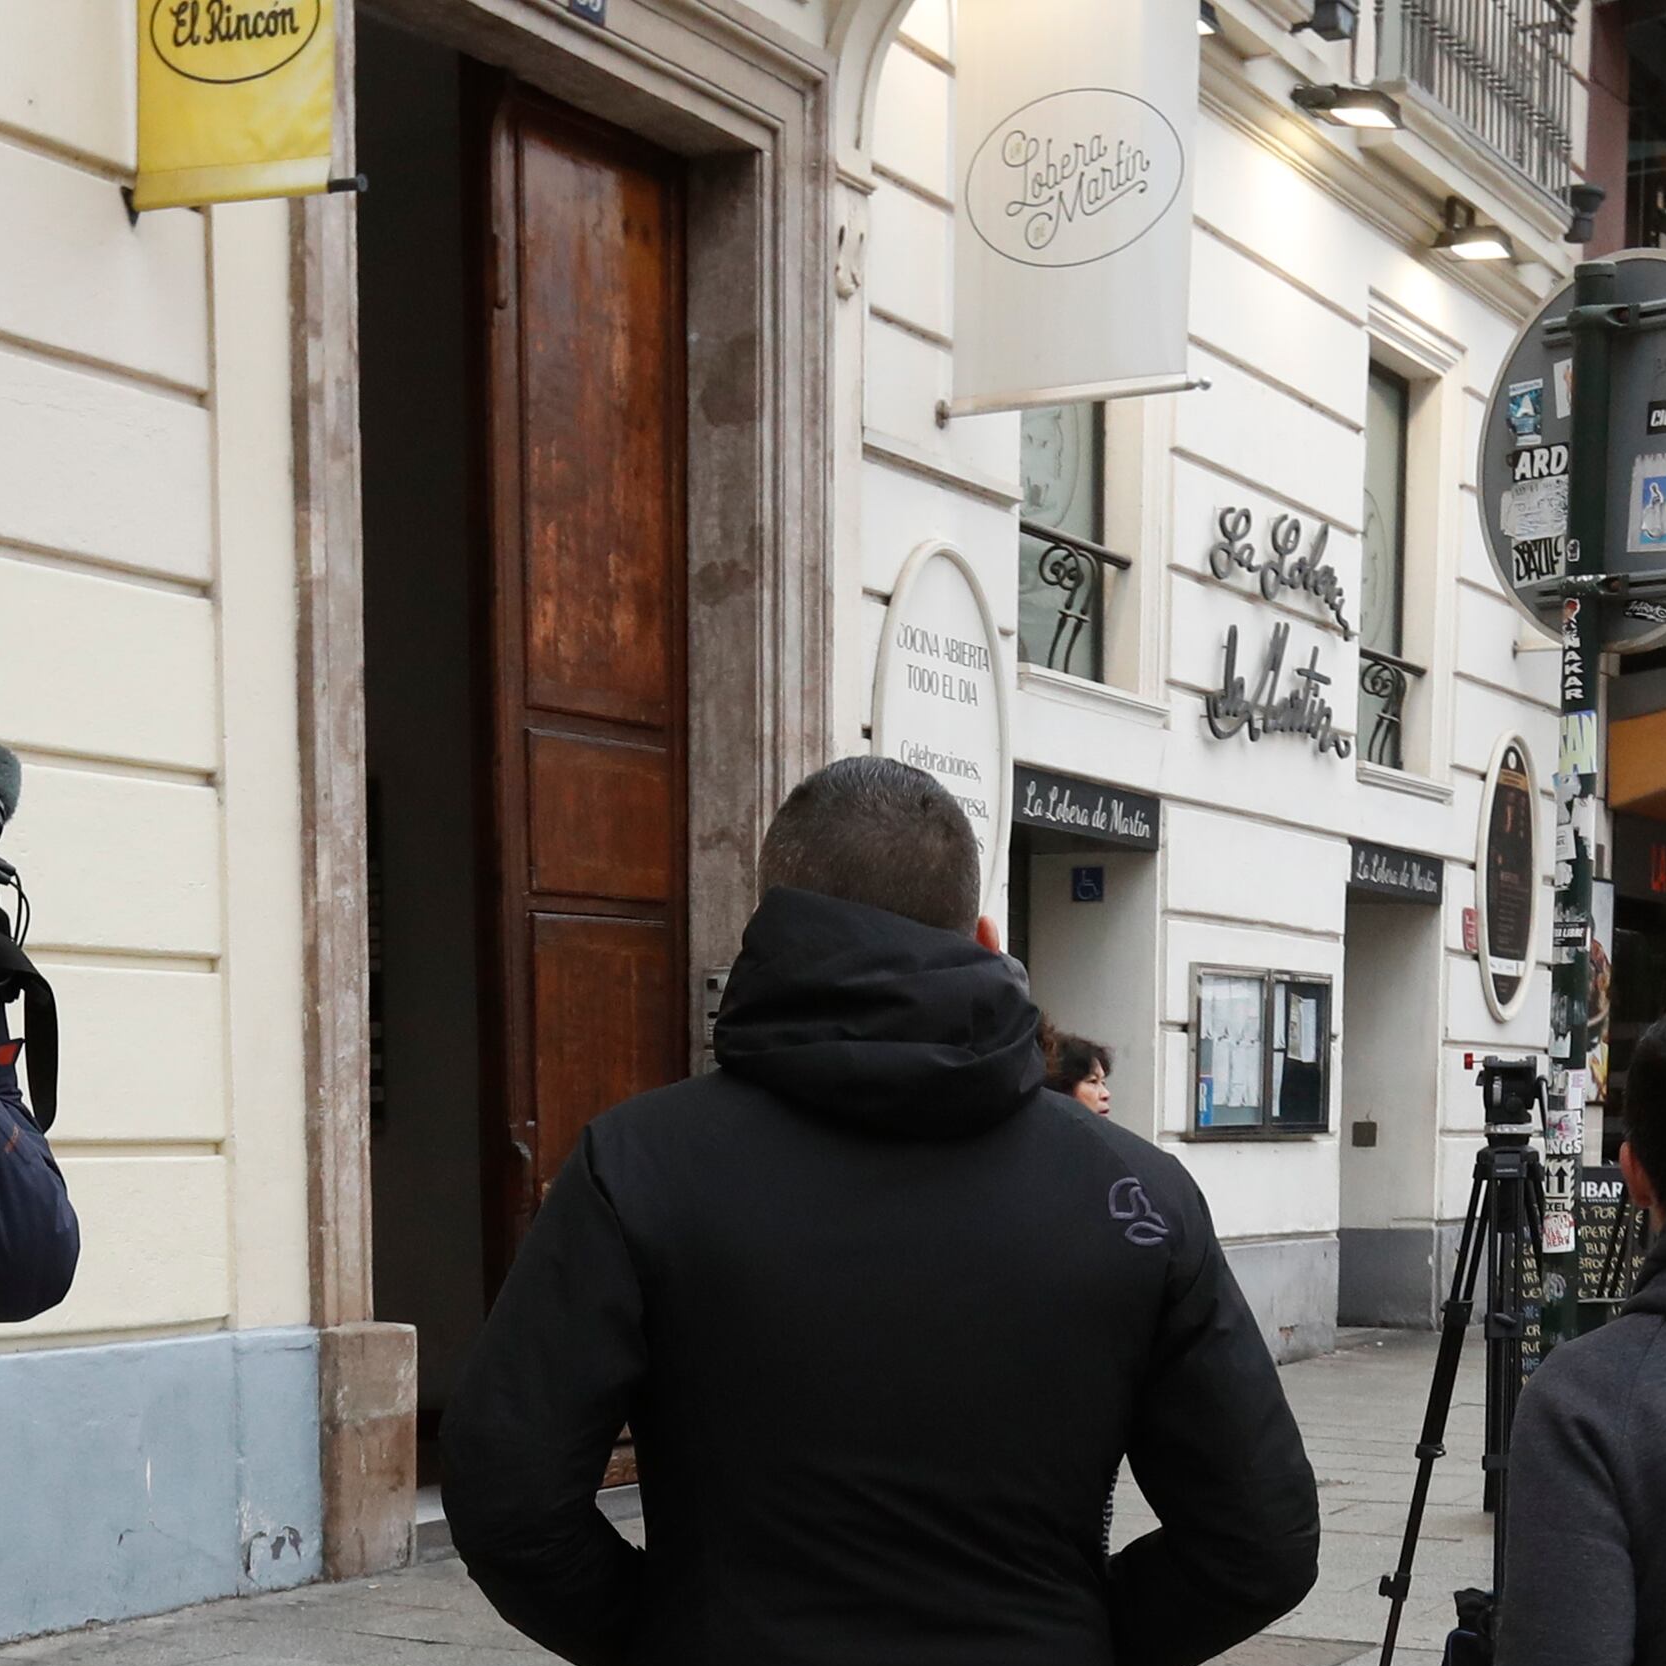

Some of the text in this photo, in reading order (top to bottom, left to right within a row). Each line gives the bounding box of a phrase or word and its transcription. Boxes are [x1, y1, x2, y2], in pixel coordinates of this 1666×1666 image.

[170, 0, 301, 47] El Rincón
[1210, 507, 1261, 580] La
[897, 623, 990, 672] COCINA ABIERTA
[907, 663, 939, 696] TODO
[942, 674, 956, 701] EL
[1023, 780, 1043, 817] La
[1045, 785, 1089, 826] Lobera
[1092, 796, 1107, 830] de
